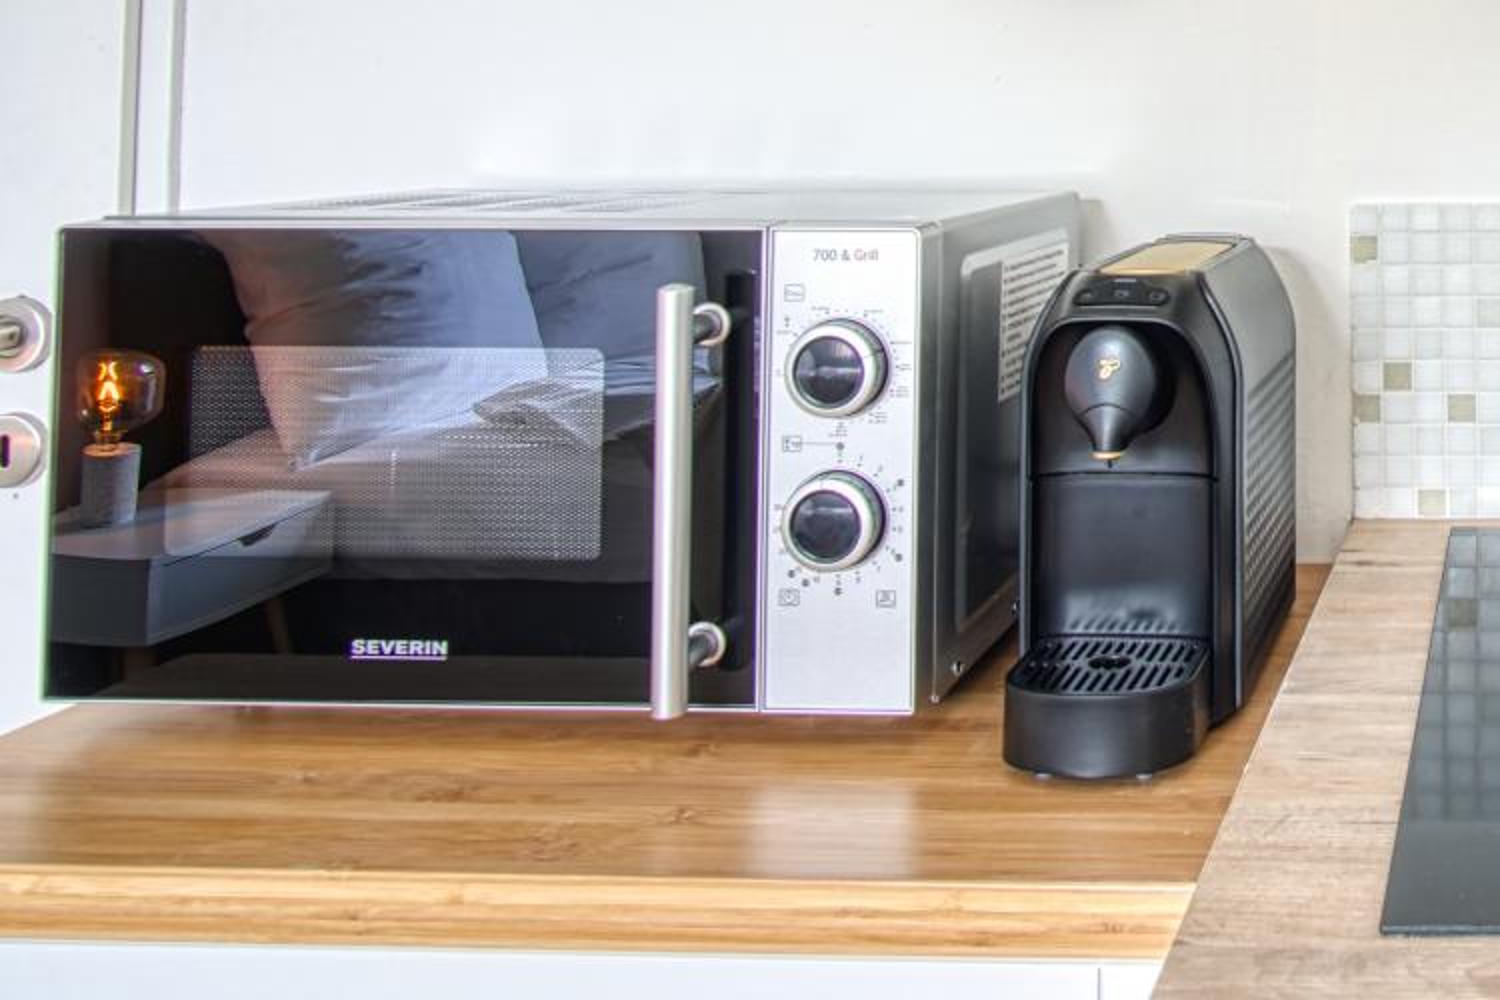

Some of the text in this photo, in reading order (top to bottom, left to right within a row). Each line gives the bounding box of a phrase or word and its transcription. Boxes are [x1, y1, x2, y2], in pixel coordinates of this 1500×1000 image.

[813, 248, 879, 261] 700 & Grill
[351, 638, 449, 656] SEVERIN
